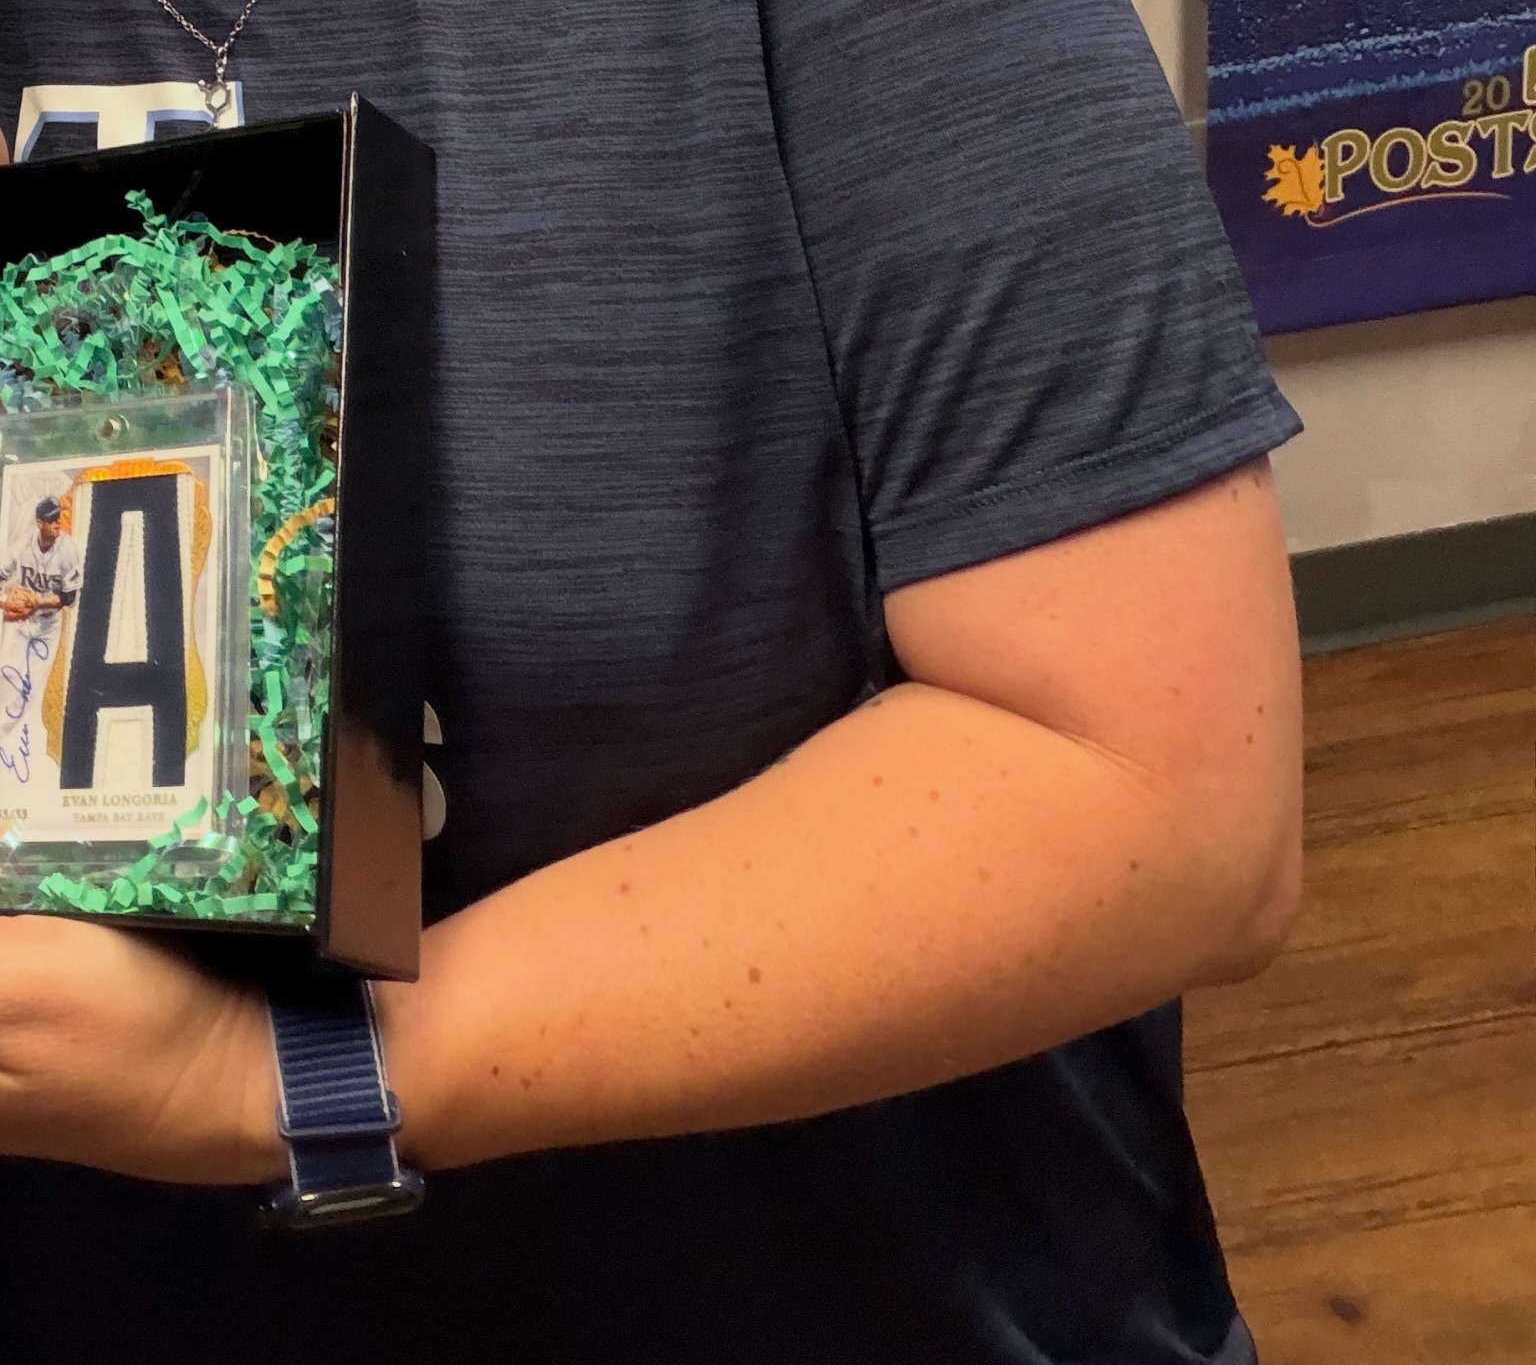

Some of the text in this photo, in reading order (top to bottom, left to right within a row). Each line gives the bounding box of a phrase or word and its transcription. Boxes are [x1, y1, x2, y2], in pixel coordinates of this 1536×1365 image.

[1321, 109, 1536, 203] POST
[20, 565, 64, 593] RAYS
[60, 474, 186, 789] A
[62, 793, 178, 808] EVAN LONGORIA
